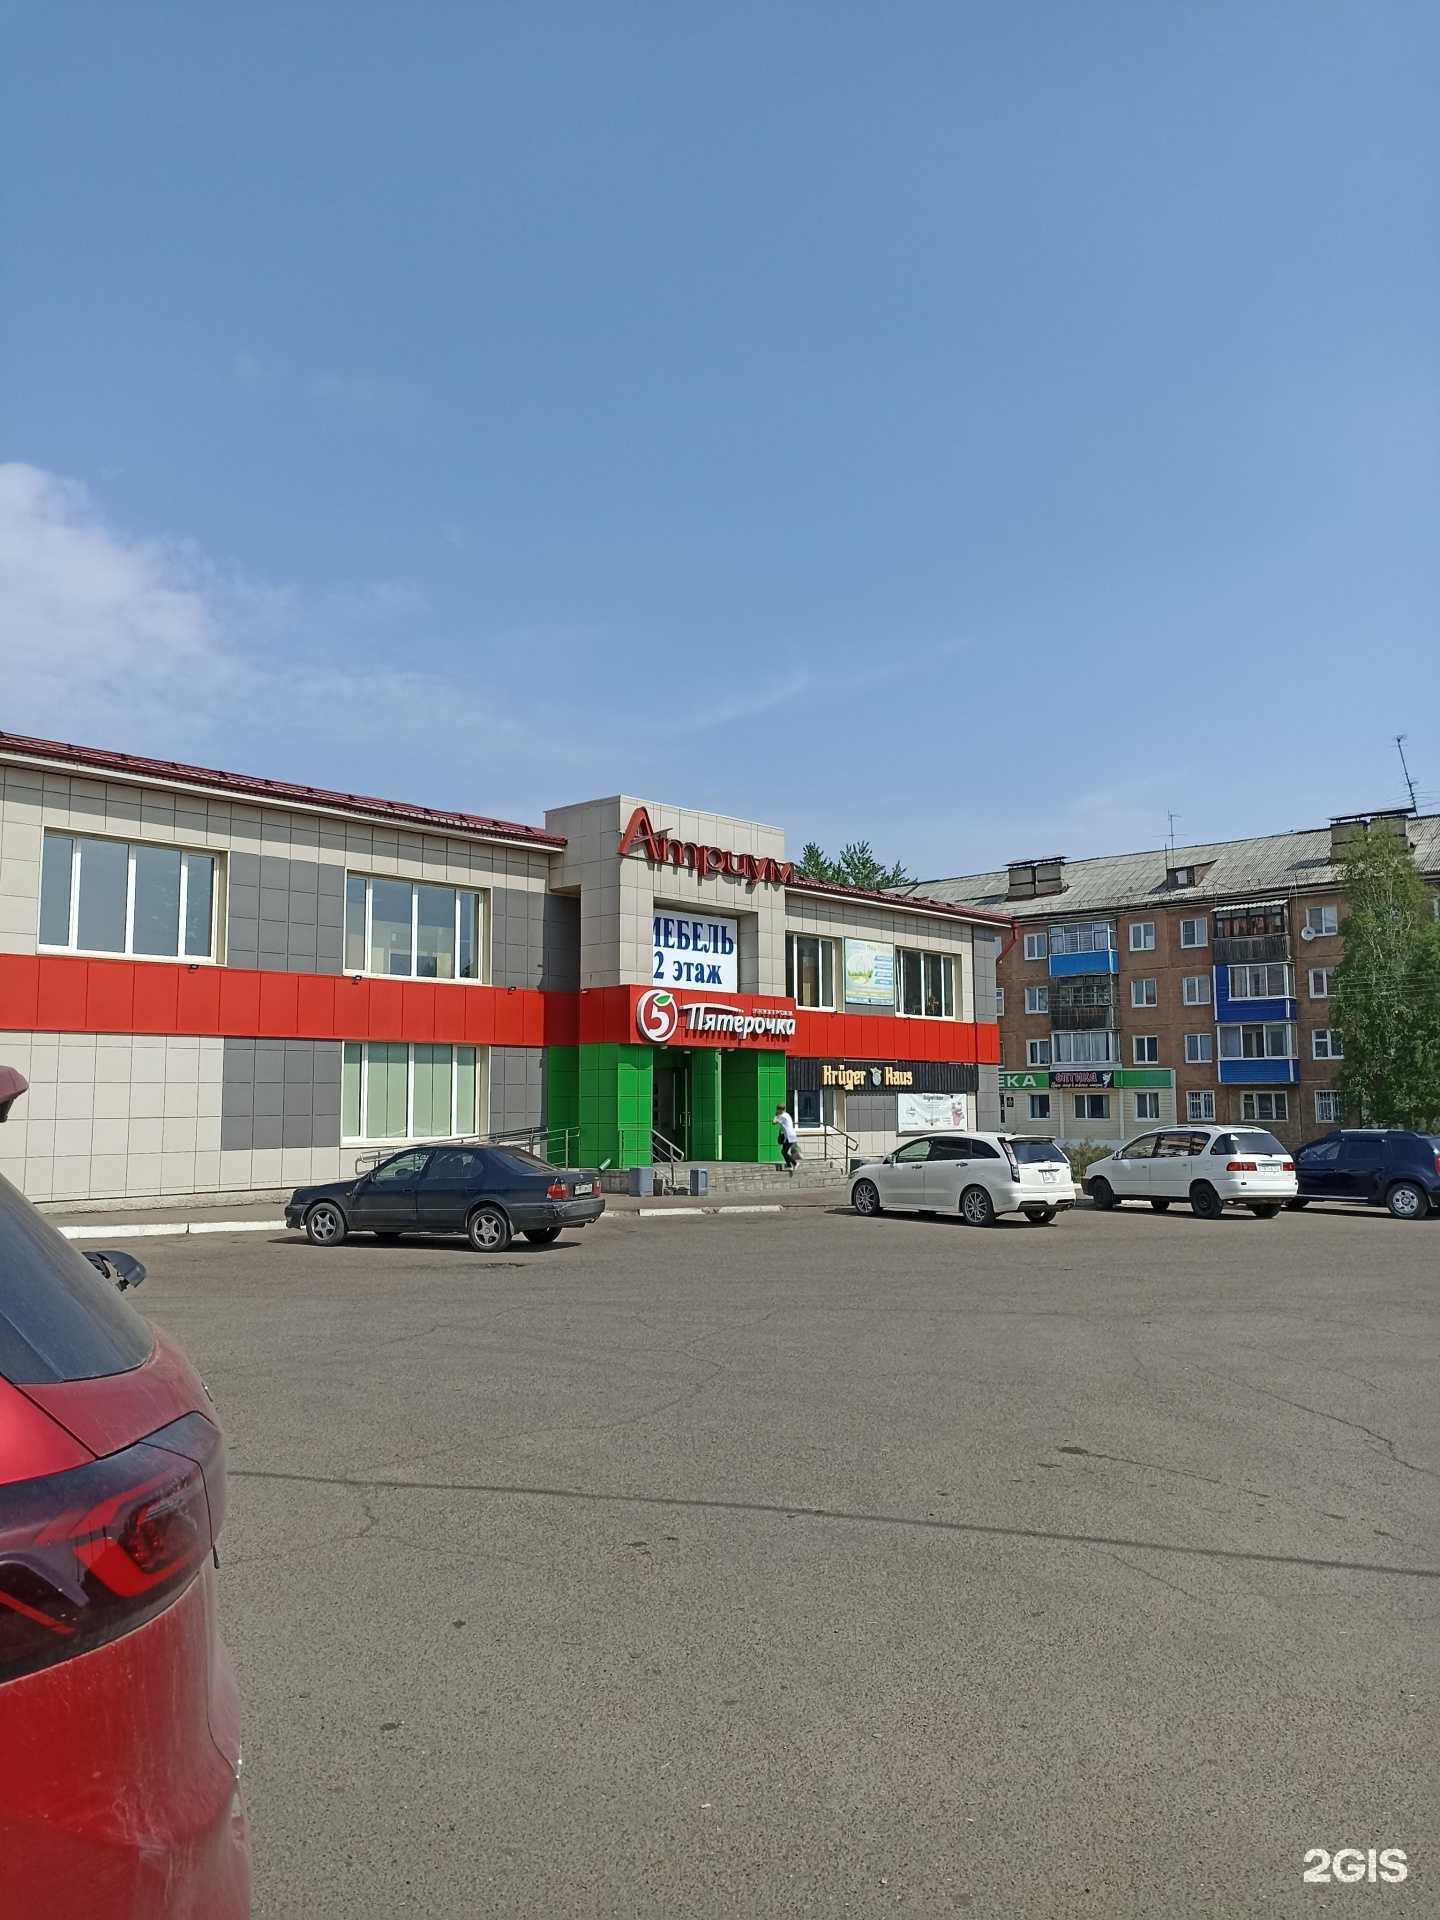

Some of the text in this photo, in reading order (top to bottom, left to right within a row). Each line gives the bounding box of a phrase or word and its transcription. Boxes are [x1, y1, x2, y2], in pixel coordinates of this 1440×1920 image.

[617, 806, 796, 886] Атриум
[653, 950, 722, 985] 2 этаж
[680, 1002, 796, 1039] Пятерочка
[822, 1065, 867, 1090] Krüger
